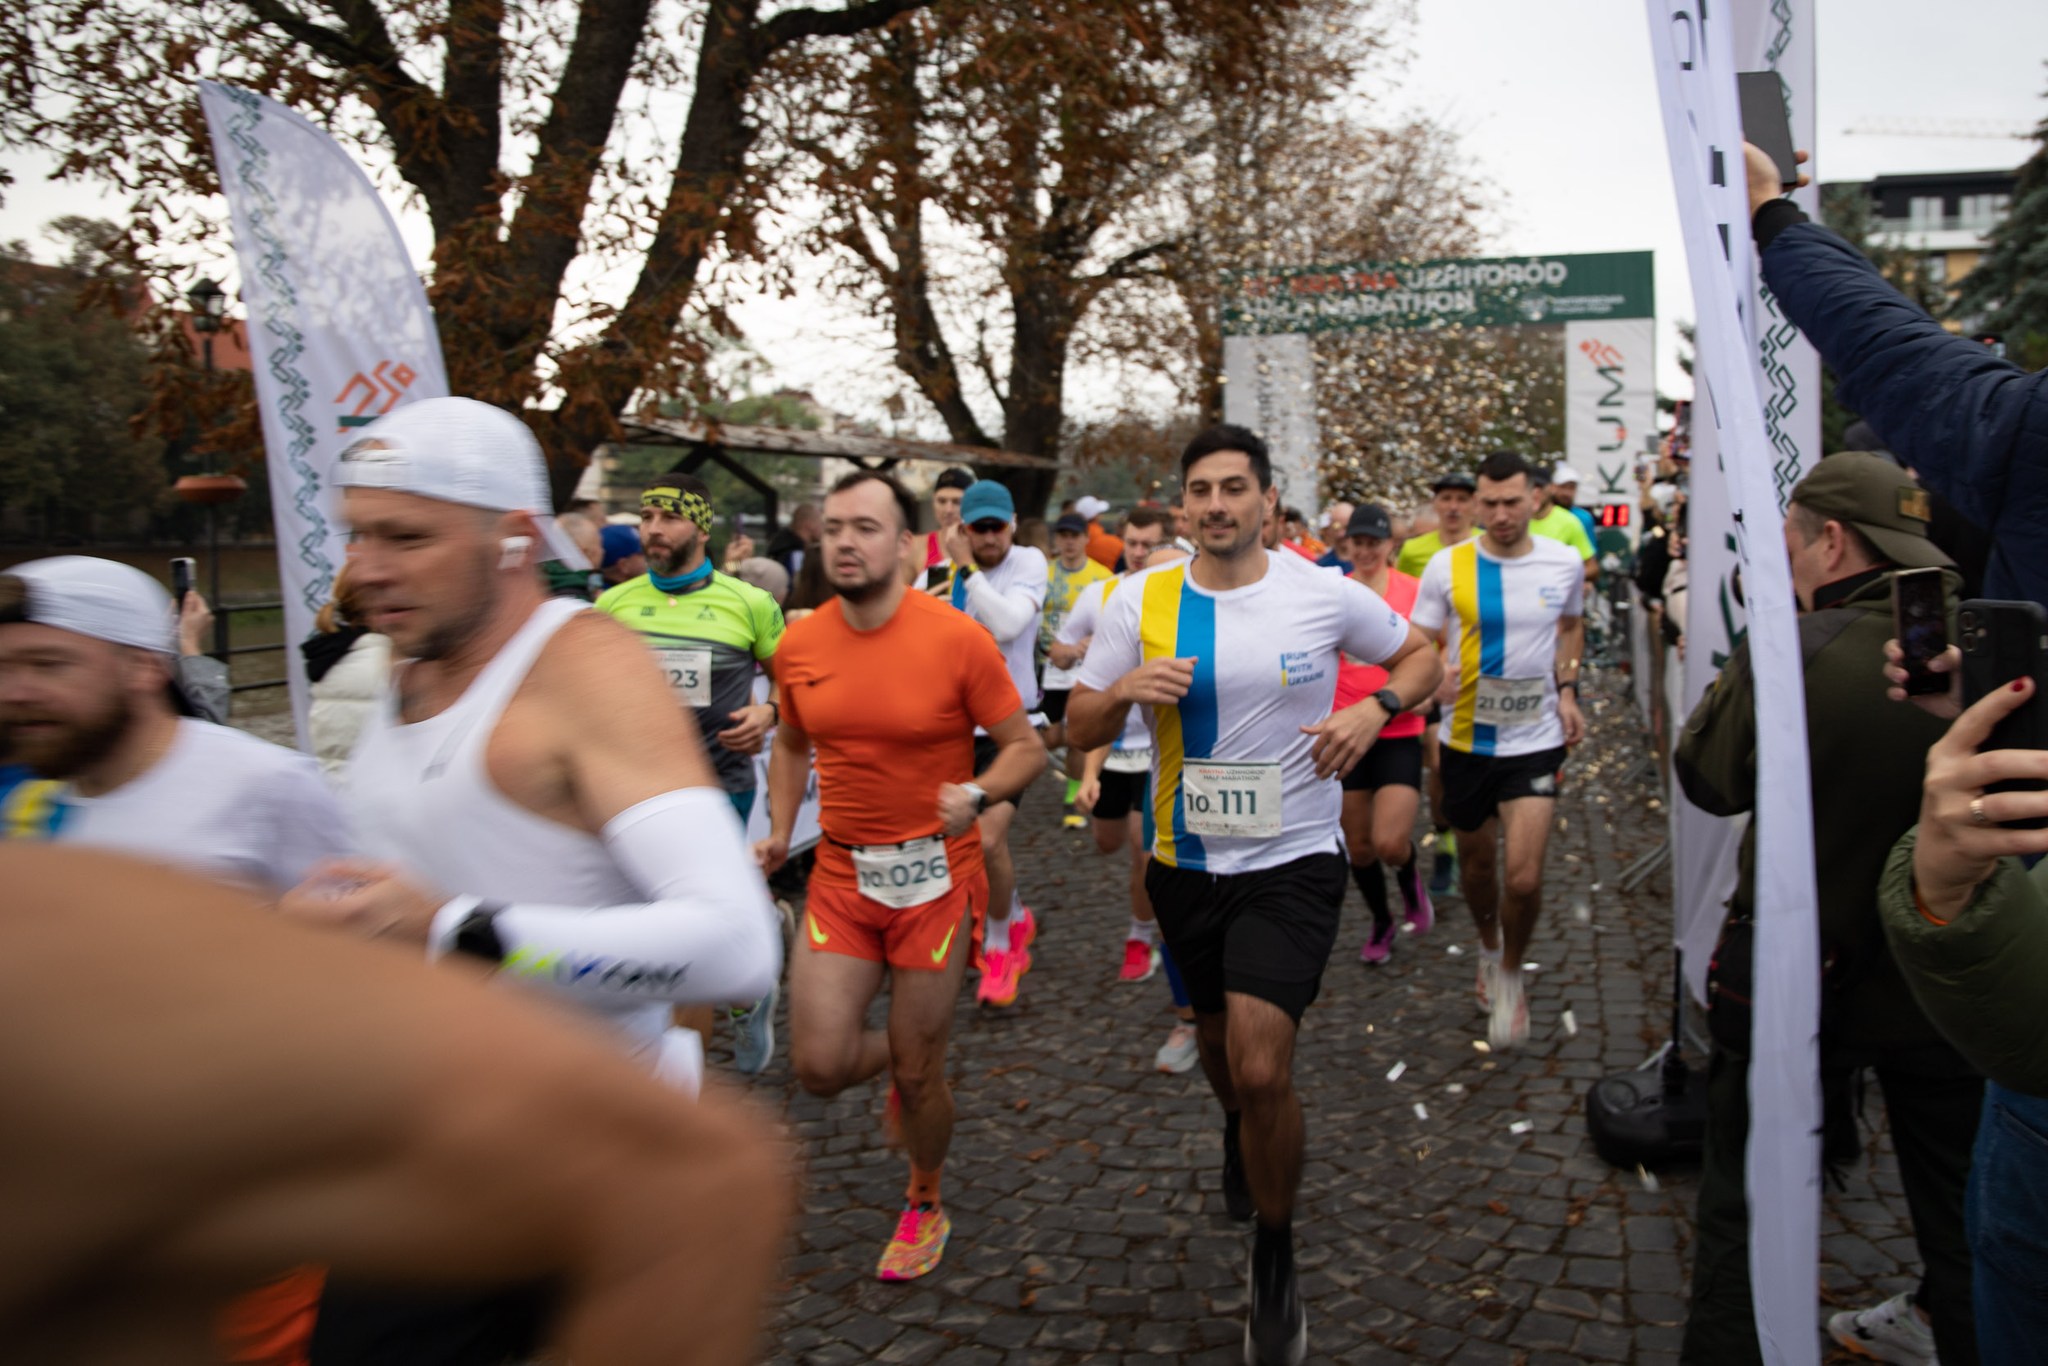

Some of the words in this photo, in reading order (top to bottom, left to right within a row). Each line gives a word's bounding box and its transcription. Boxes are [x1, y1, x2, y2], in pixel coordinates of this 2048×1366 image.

[1286, 651, 1308, 661] RUN
[1288, 663, 1312, 673] WITH
[1288, 670, 1324, 687] UKRAINE
[1478, 696, 1494, 709] 21
[1501, 695, 1542, 712] 087
[1186, 793, 1210, 813] 10
[1218, 790, 1256, 815] 111
[890, 855, 948, 888] 026
